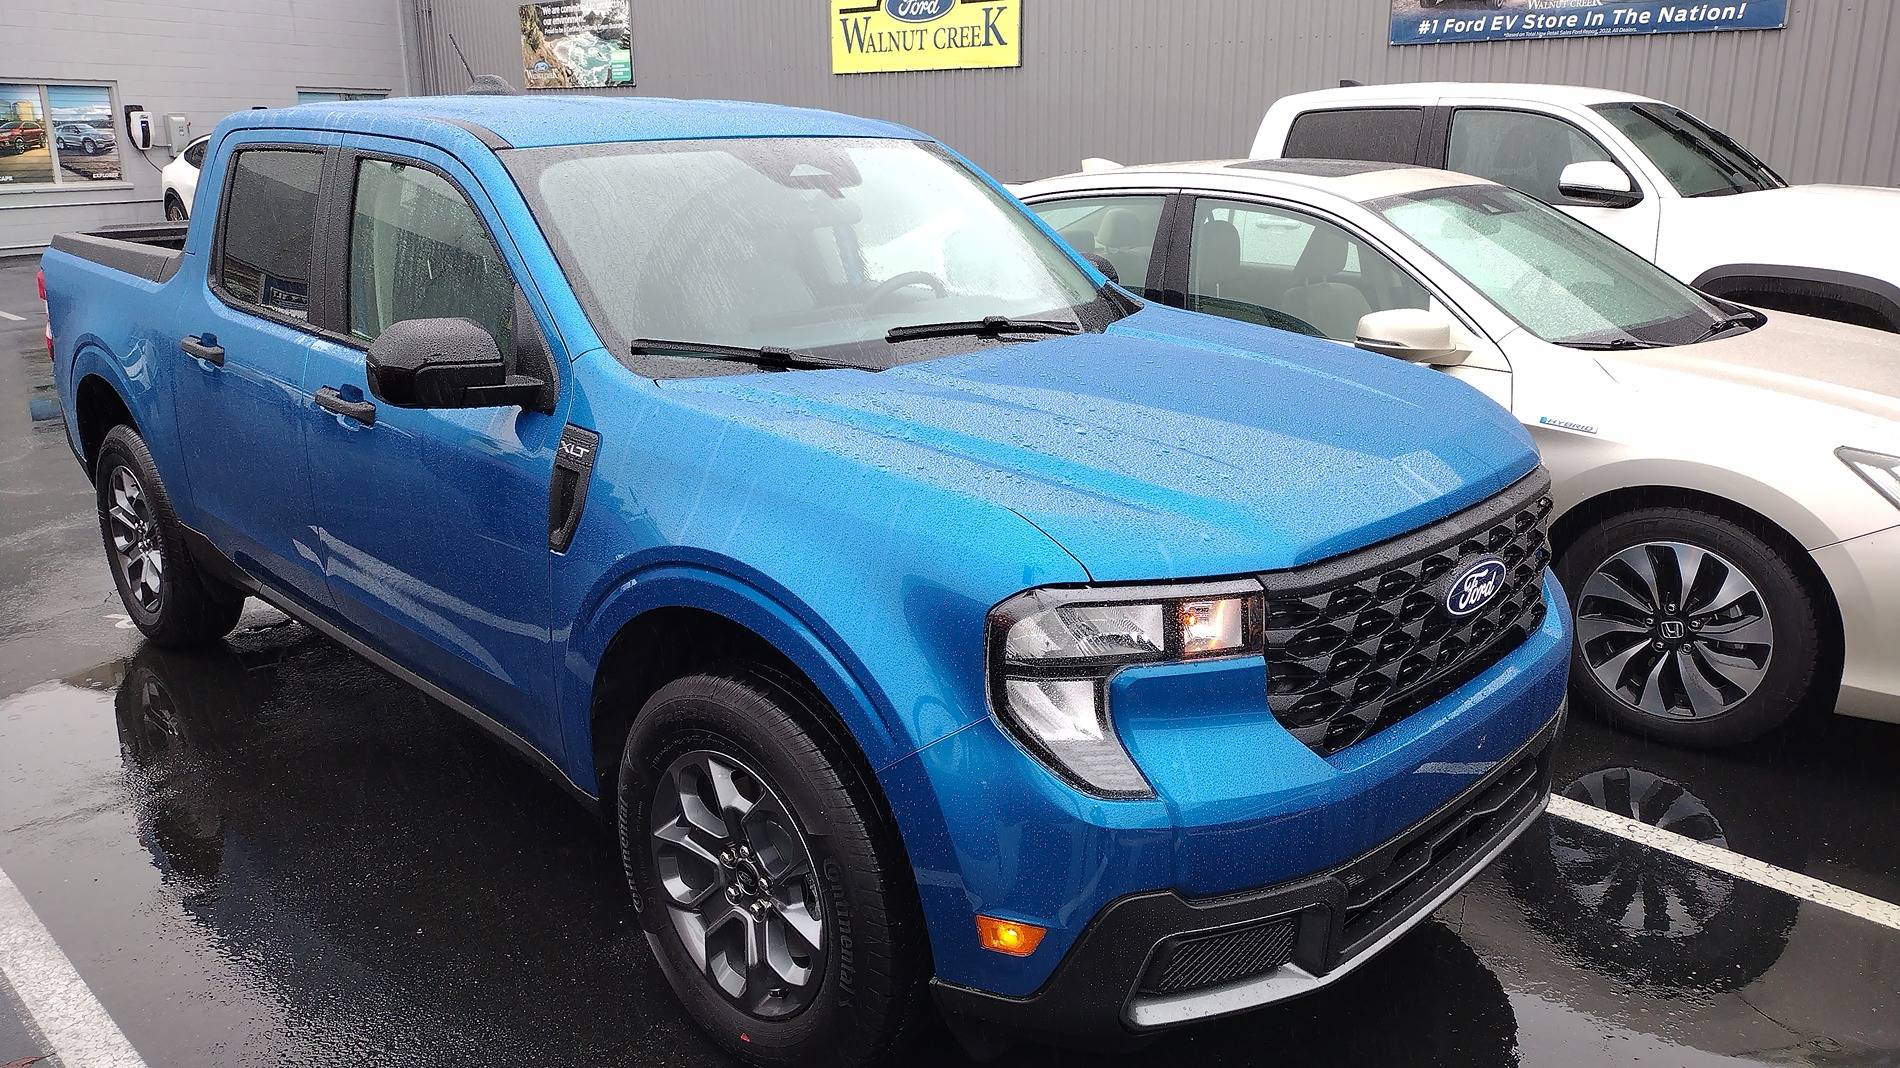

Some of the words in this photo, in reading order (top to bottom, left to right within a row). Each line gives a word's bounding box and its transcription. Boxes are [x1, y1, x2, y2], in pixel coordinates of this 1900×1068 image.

[898, 0, 941, 15] Ford
[1418, 20, 1439, 34] #1
[1443, 17, 1487, 33] Ford
[1491, 15, 1519, 31] EV
[1522, 13, 1578, 29] Store
[1584, 11, 1604, 27] In
[1612, 8, 1651, 26] The
[1657, 3, 1747, 24] Nation!
[840, 16, 928, 54] WALNUT
[933, 6, 1008, 50] CREEK
[1547, 418, 1594, 431] HYBRID
[559, 440, 590, 458] XLT
[1458, 568, 1497, 610] Ford
